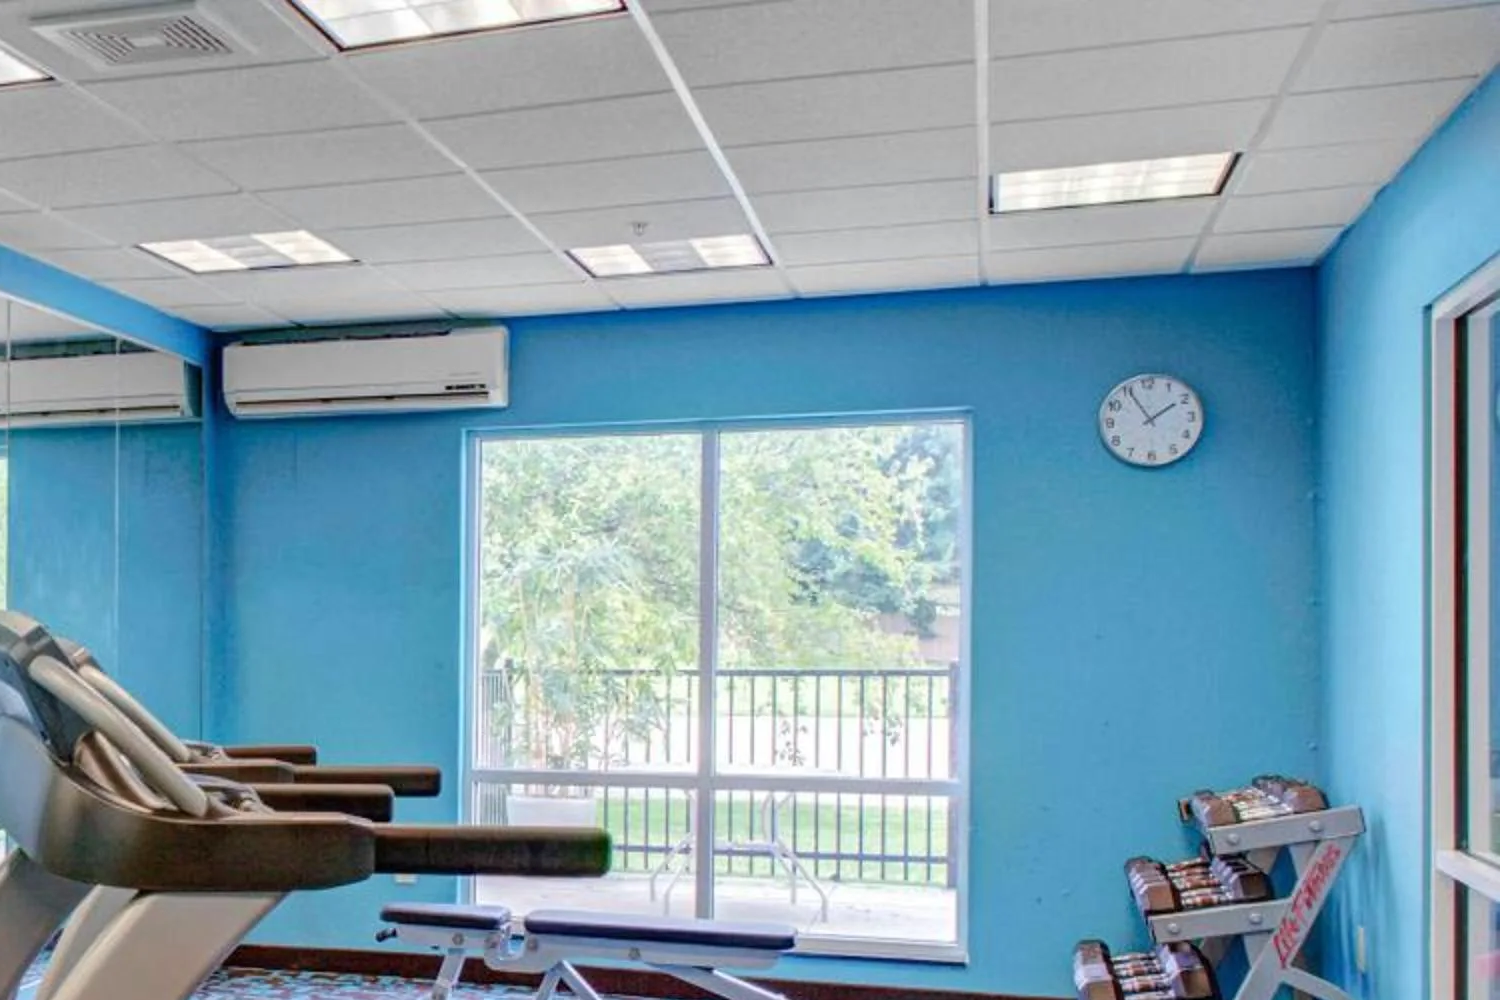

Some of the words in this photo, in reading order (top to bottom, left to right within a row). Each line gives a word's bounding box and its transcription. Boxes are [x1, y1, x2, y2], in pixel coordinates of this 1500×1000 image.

[1180, 393, 1189, 405] 2
[1108, 400, 1122, 412] 10
[1187, 411, 1196, 423] 3
[1126, 447, 1135, 458] 7
